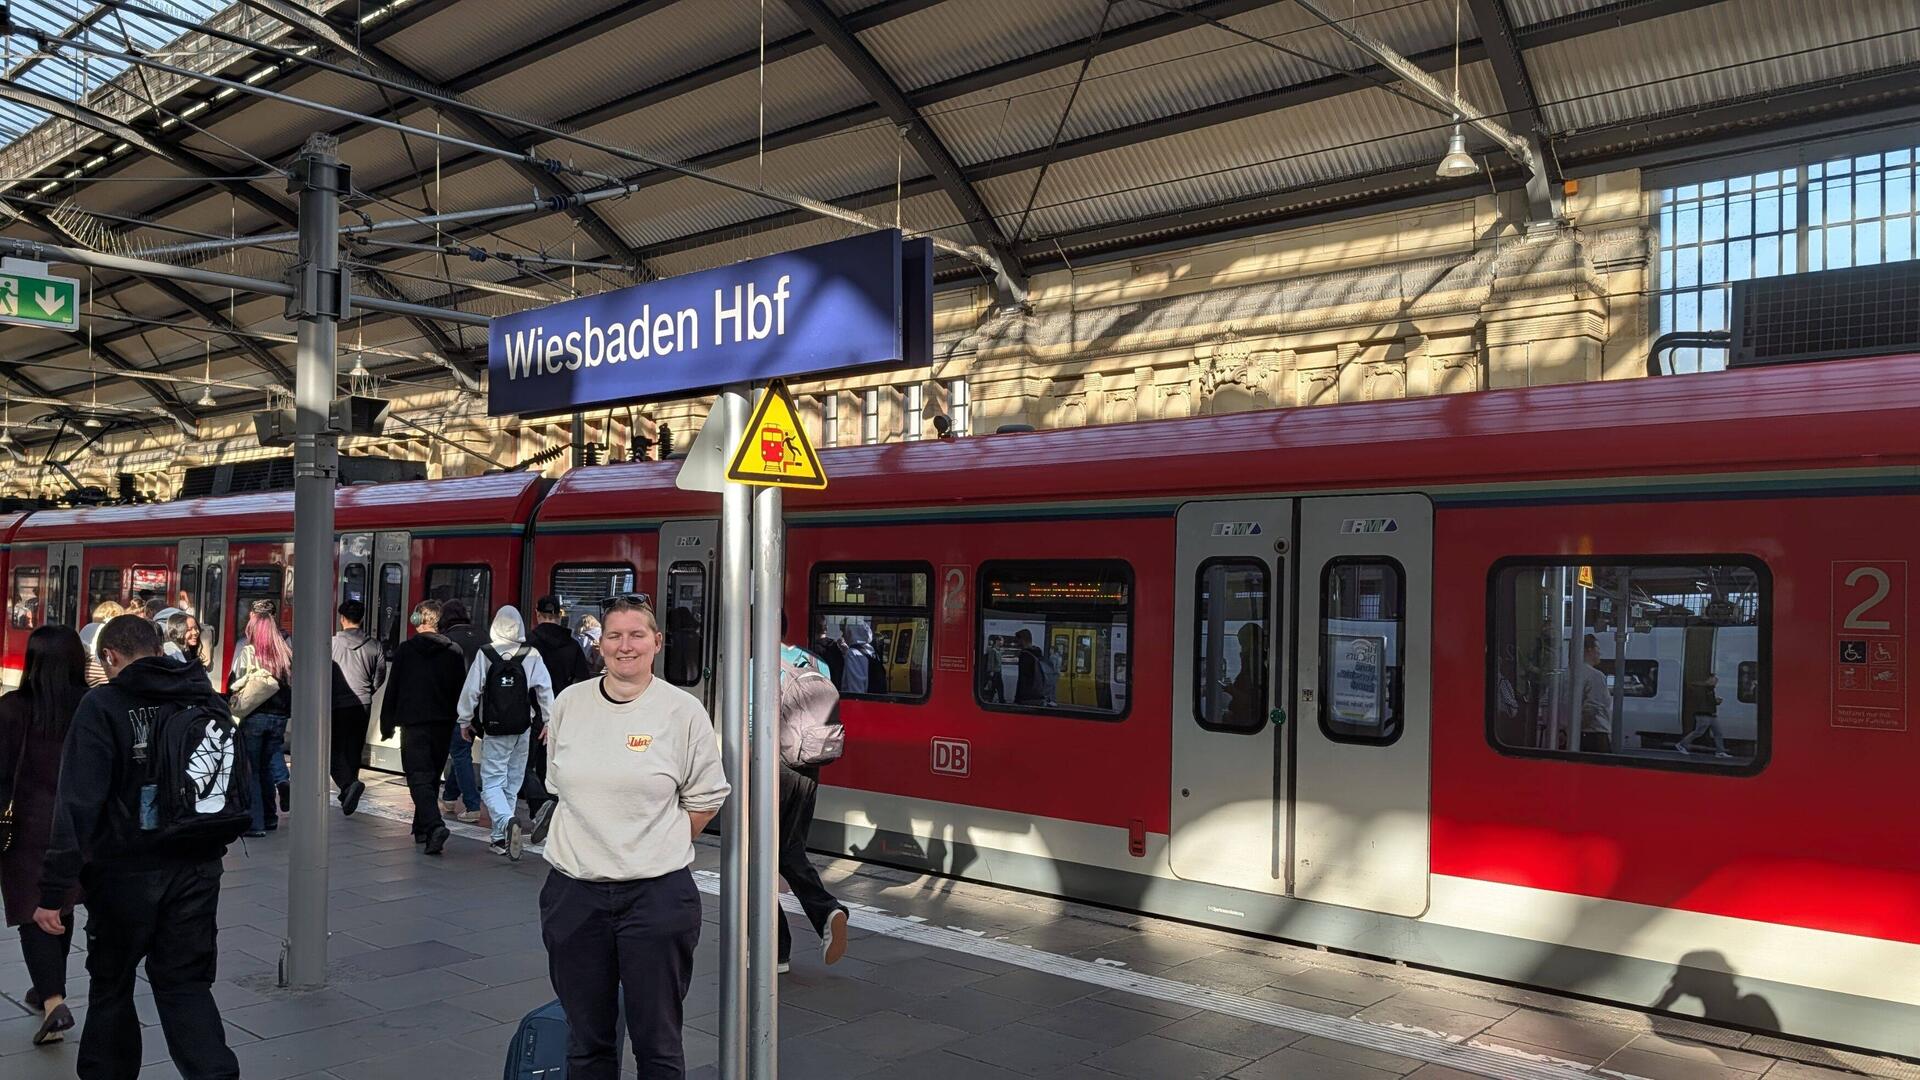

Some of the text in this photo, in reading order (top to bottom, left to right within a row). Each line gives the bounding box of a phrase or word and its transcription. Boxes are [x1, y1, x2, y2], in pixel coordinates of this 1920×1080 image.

[504, 275, 790, 381] Wiesbaden Hbf
[945, 568, 965, 608] 2
[1843, 567, 1890, 630] 2
[935, 744, 966, 771] DB
